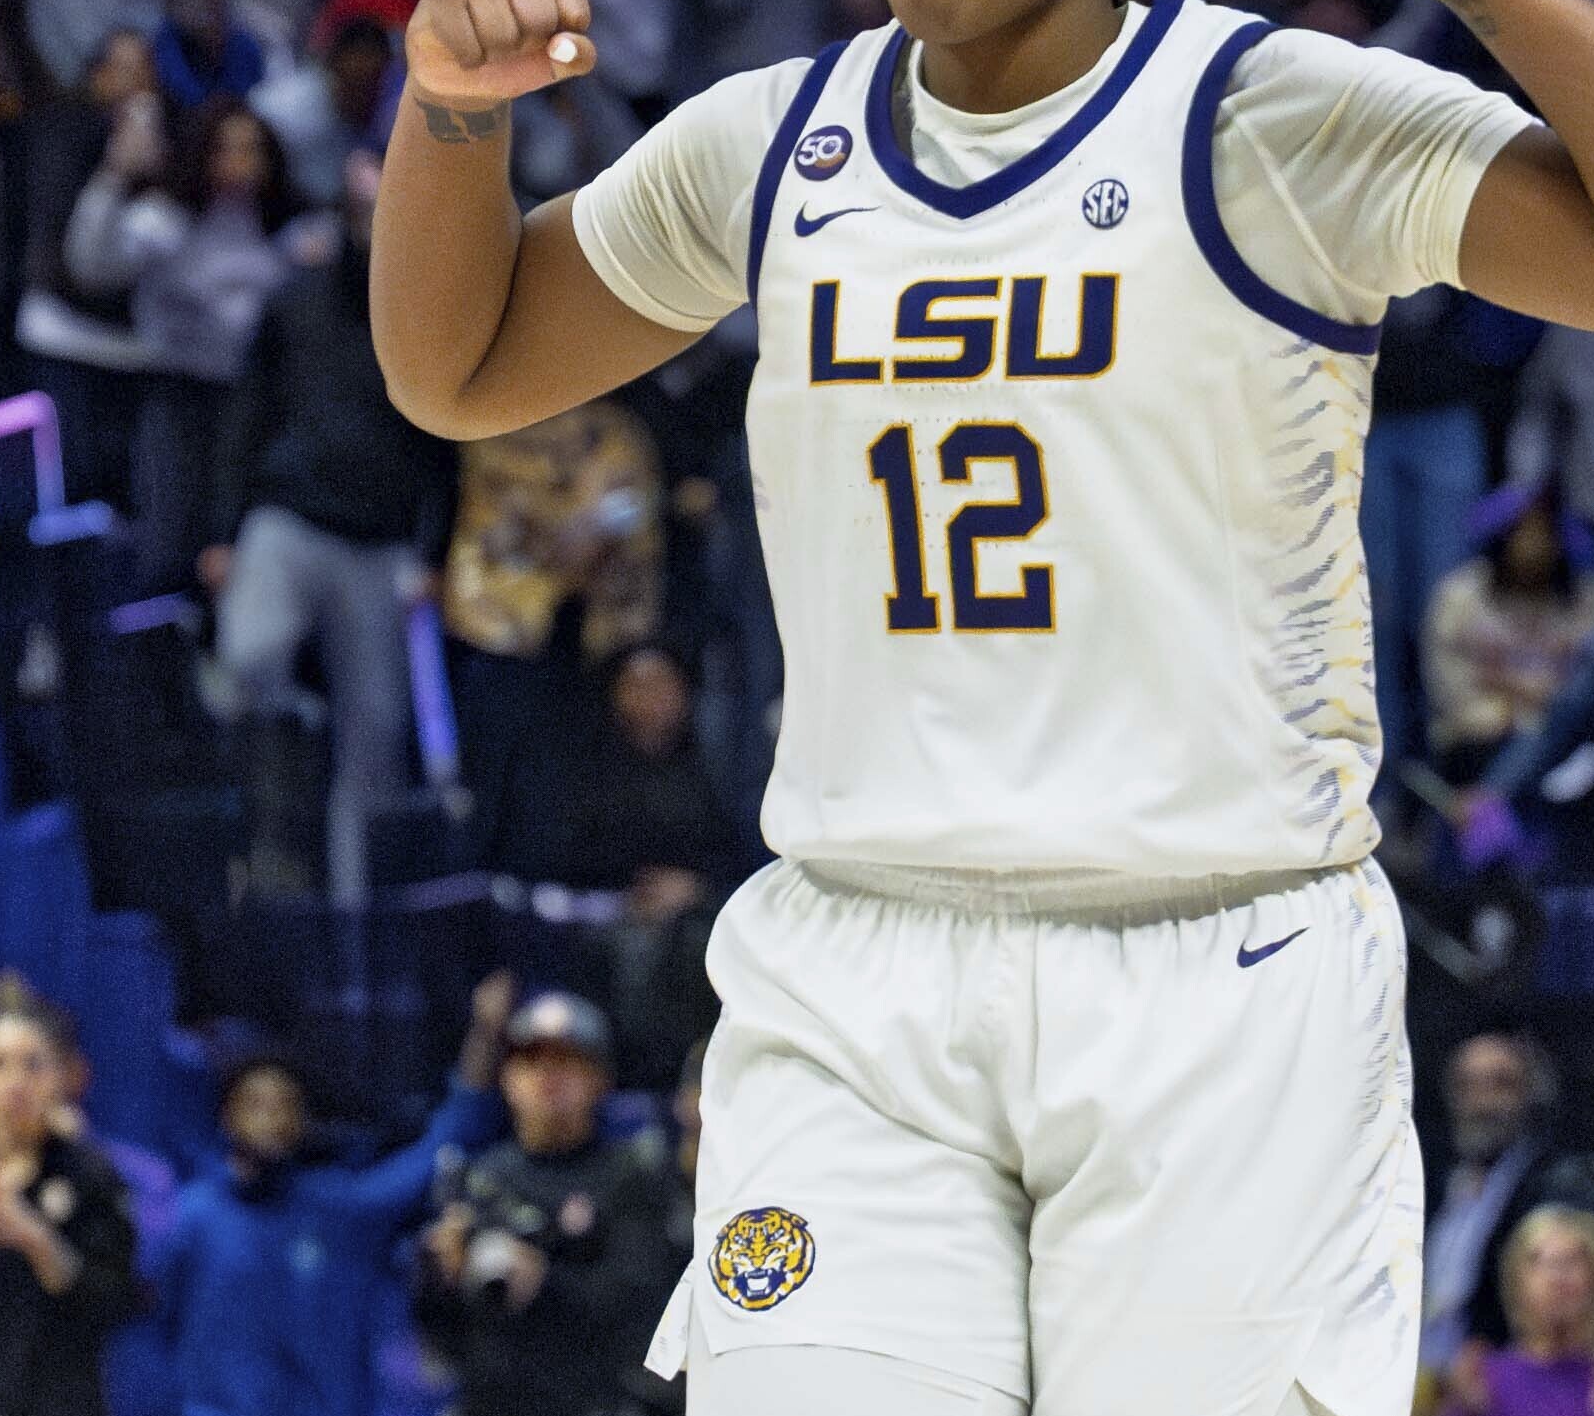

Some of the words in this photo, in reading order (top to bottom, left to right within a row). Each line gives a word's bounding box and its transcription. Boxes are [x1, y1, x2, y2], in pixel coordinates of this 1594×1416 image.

[797, 134, 843, 166] 50
[1084, 181, 1127, 225] SEC
[809, 272, 1121, 386] LSU
[867, 421, 1055, 634] 12
